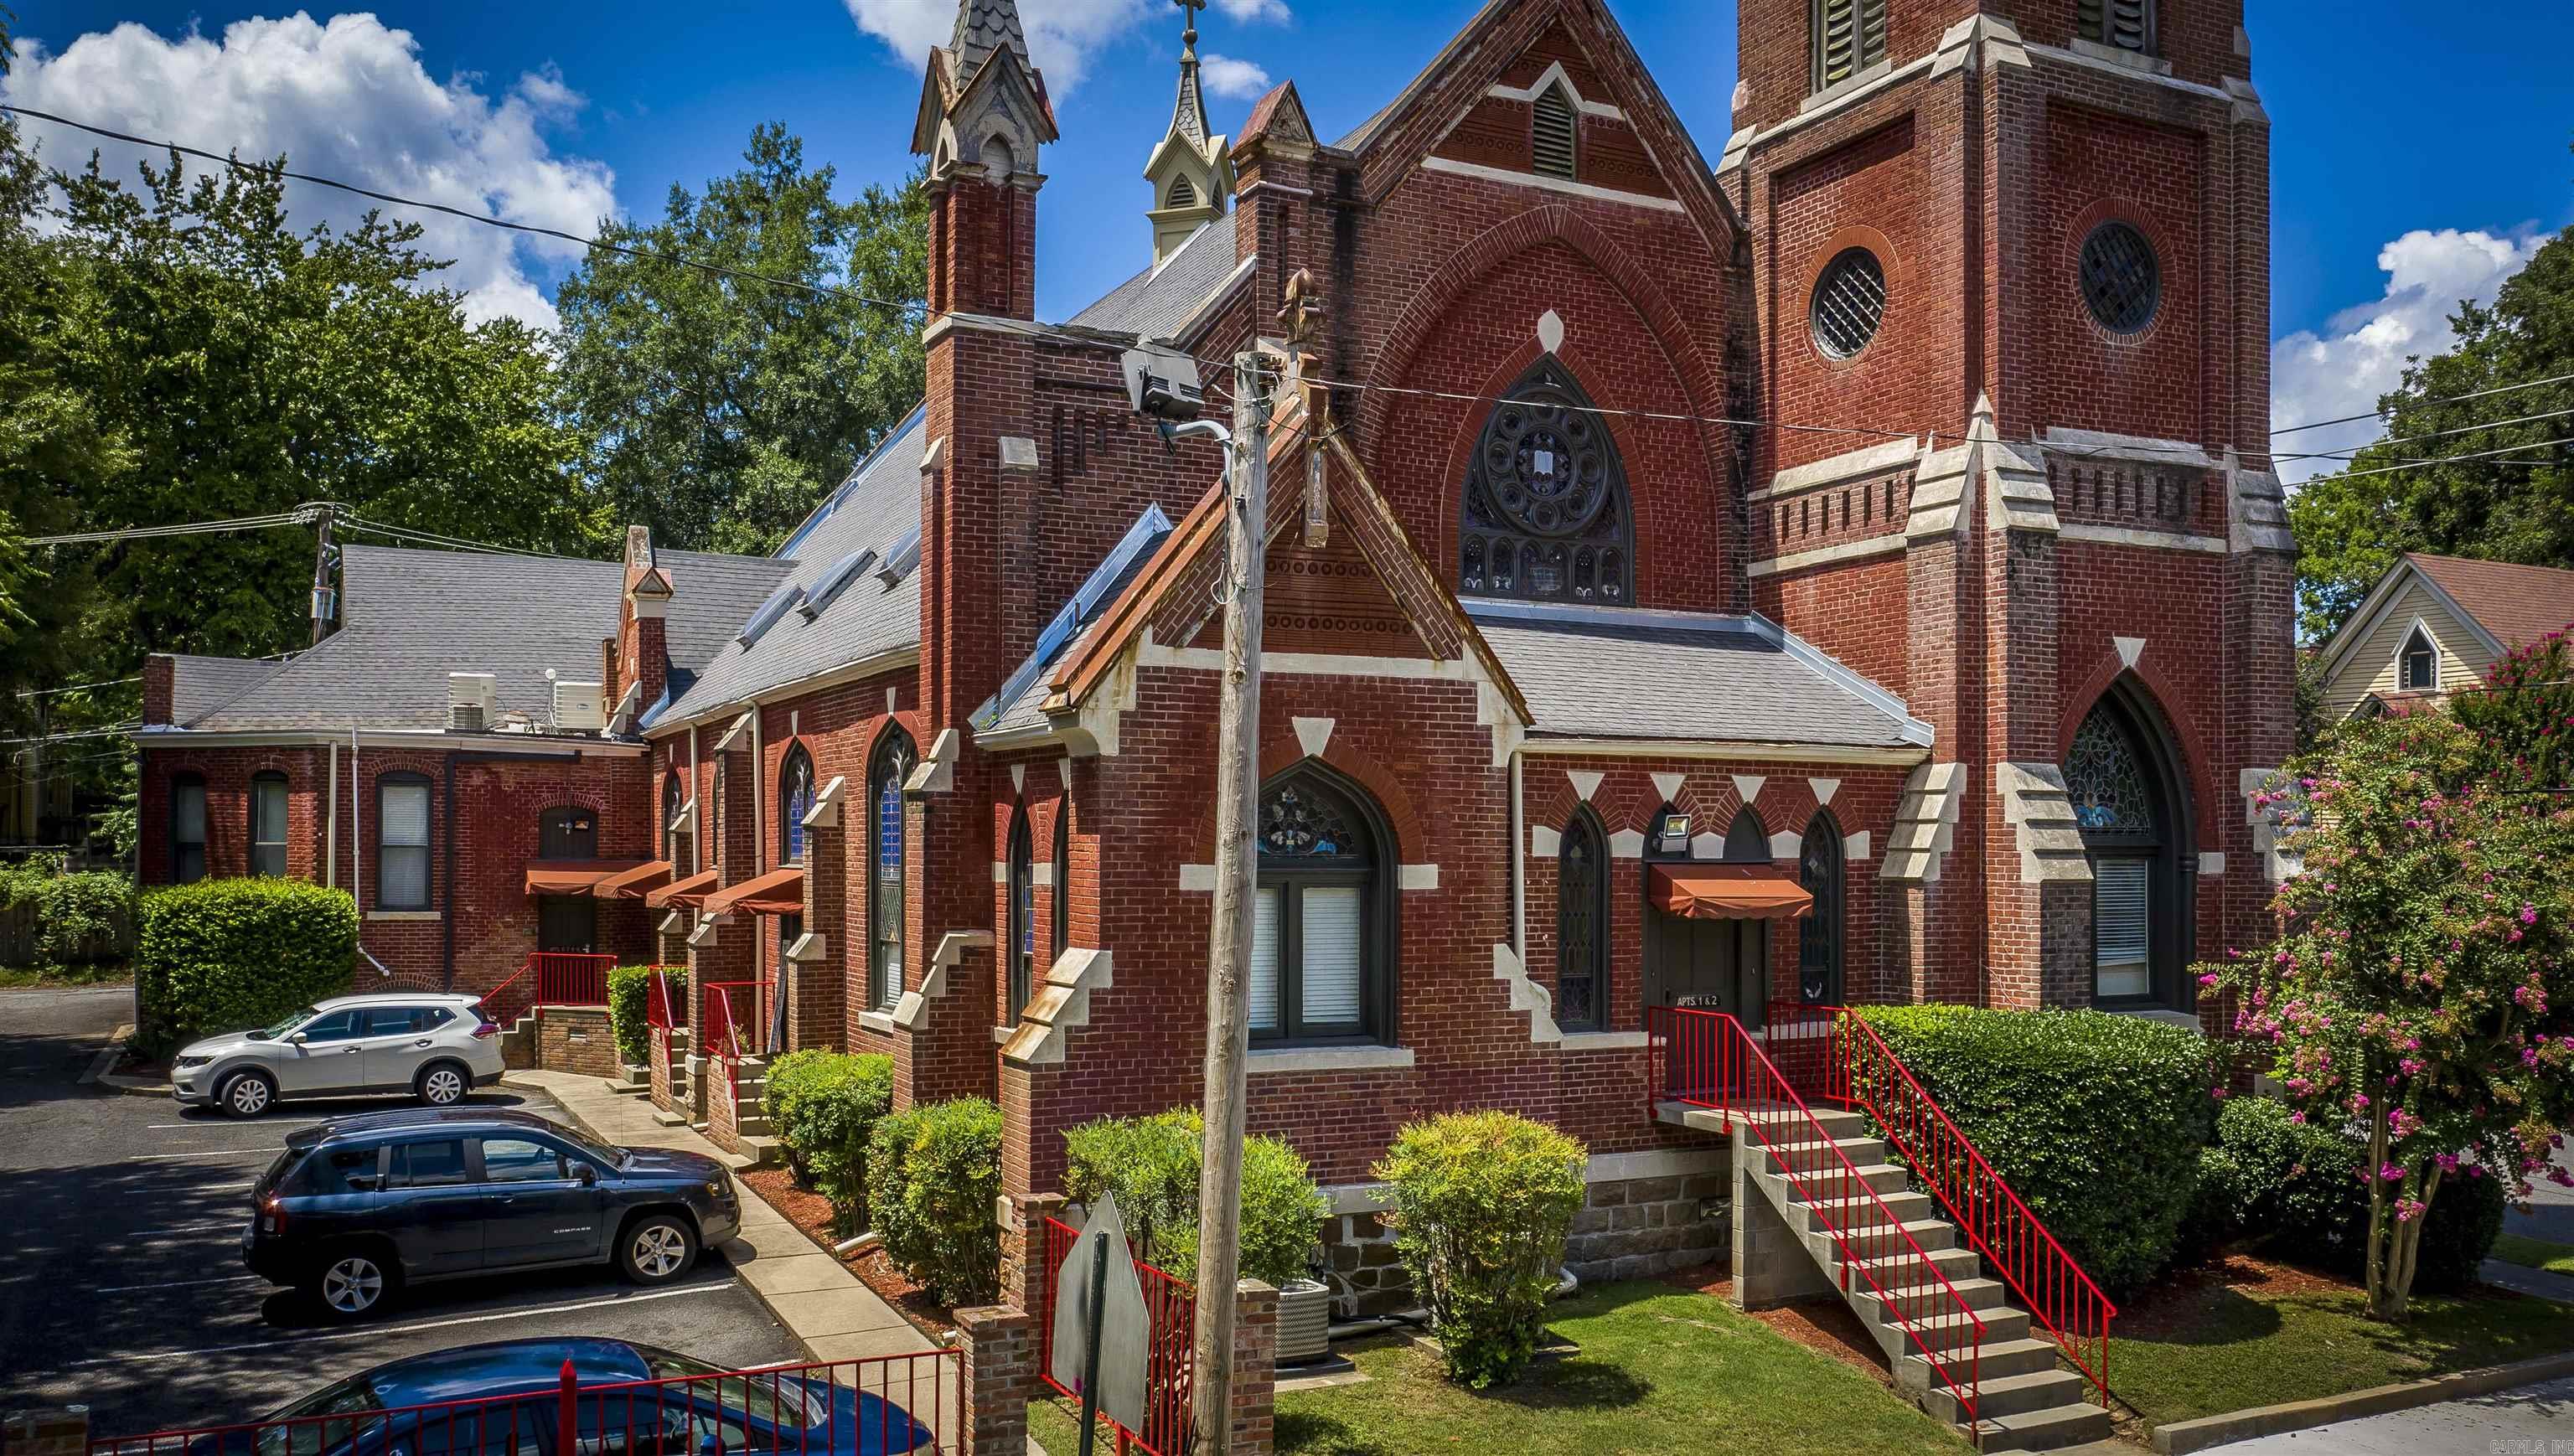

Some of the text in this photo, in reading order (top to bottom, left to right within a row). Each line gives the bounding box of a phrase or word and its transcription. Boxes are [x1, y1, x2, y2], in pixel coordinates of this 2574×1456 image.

[1677, 995, 1717, 1006] APTS. 1 & 2
